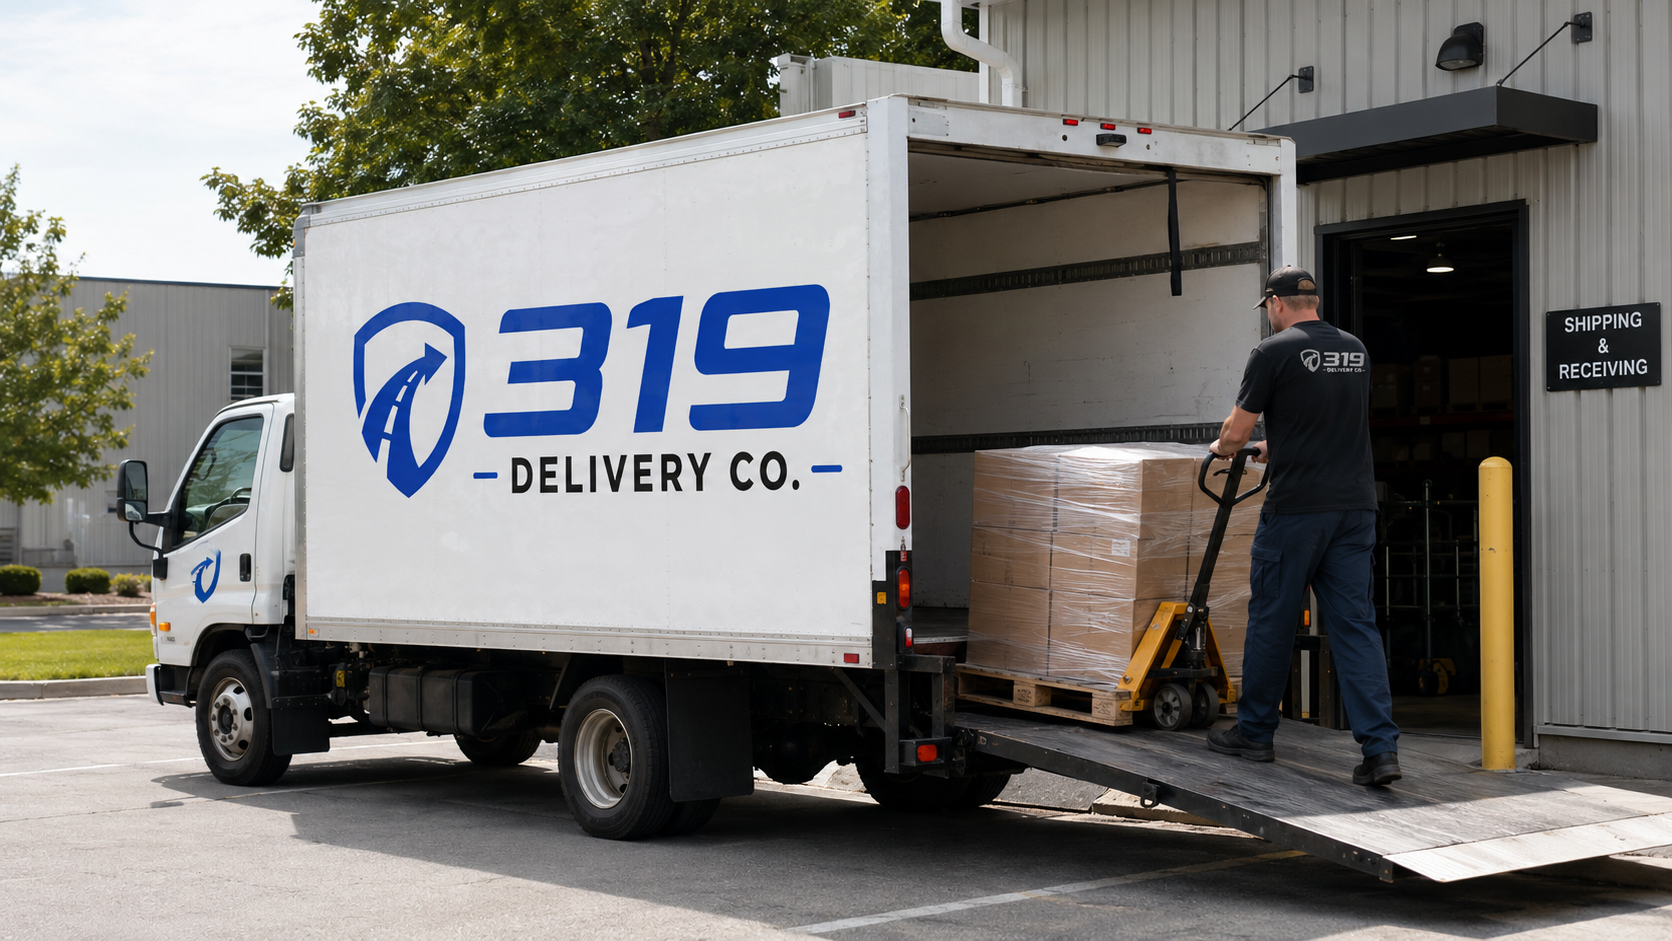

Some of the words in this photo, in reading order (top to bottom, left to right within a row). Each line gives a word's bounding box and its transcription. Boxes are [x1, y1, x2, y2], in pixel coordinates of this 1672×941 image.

[1564, 311, 1642, 333] SHIPPING
[1598, 338, 1609, 354] &
[483, 284, 830, 438] 319
[1323, 352, 1365, 367] 319
[1559, 358, 1648, 380] RECEIVING
[511, 452, 712, 494] DELIVERY
[730, 451, 800, 492] CO.
